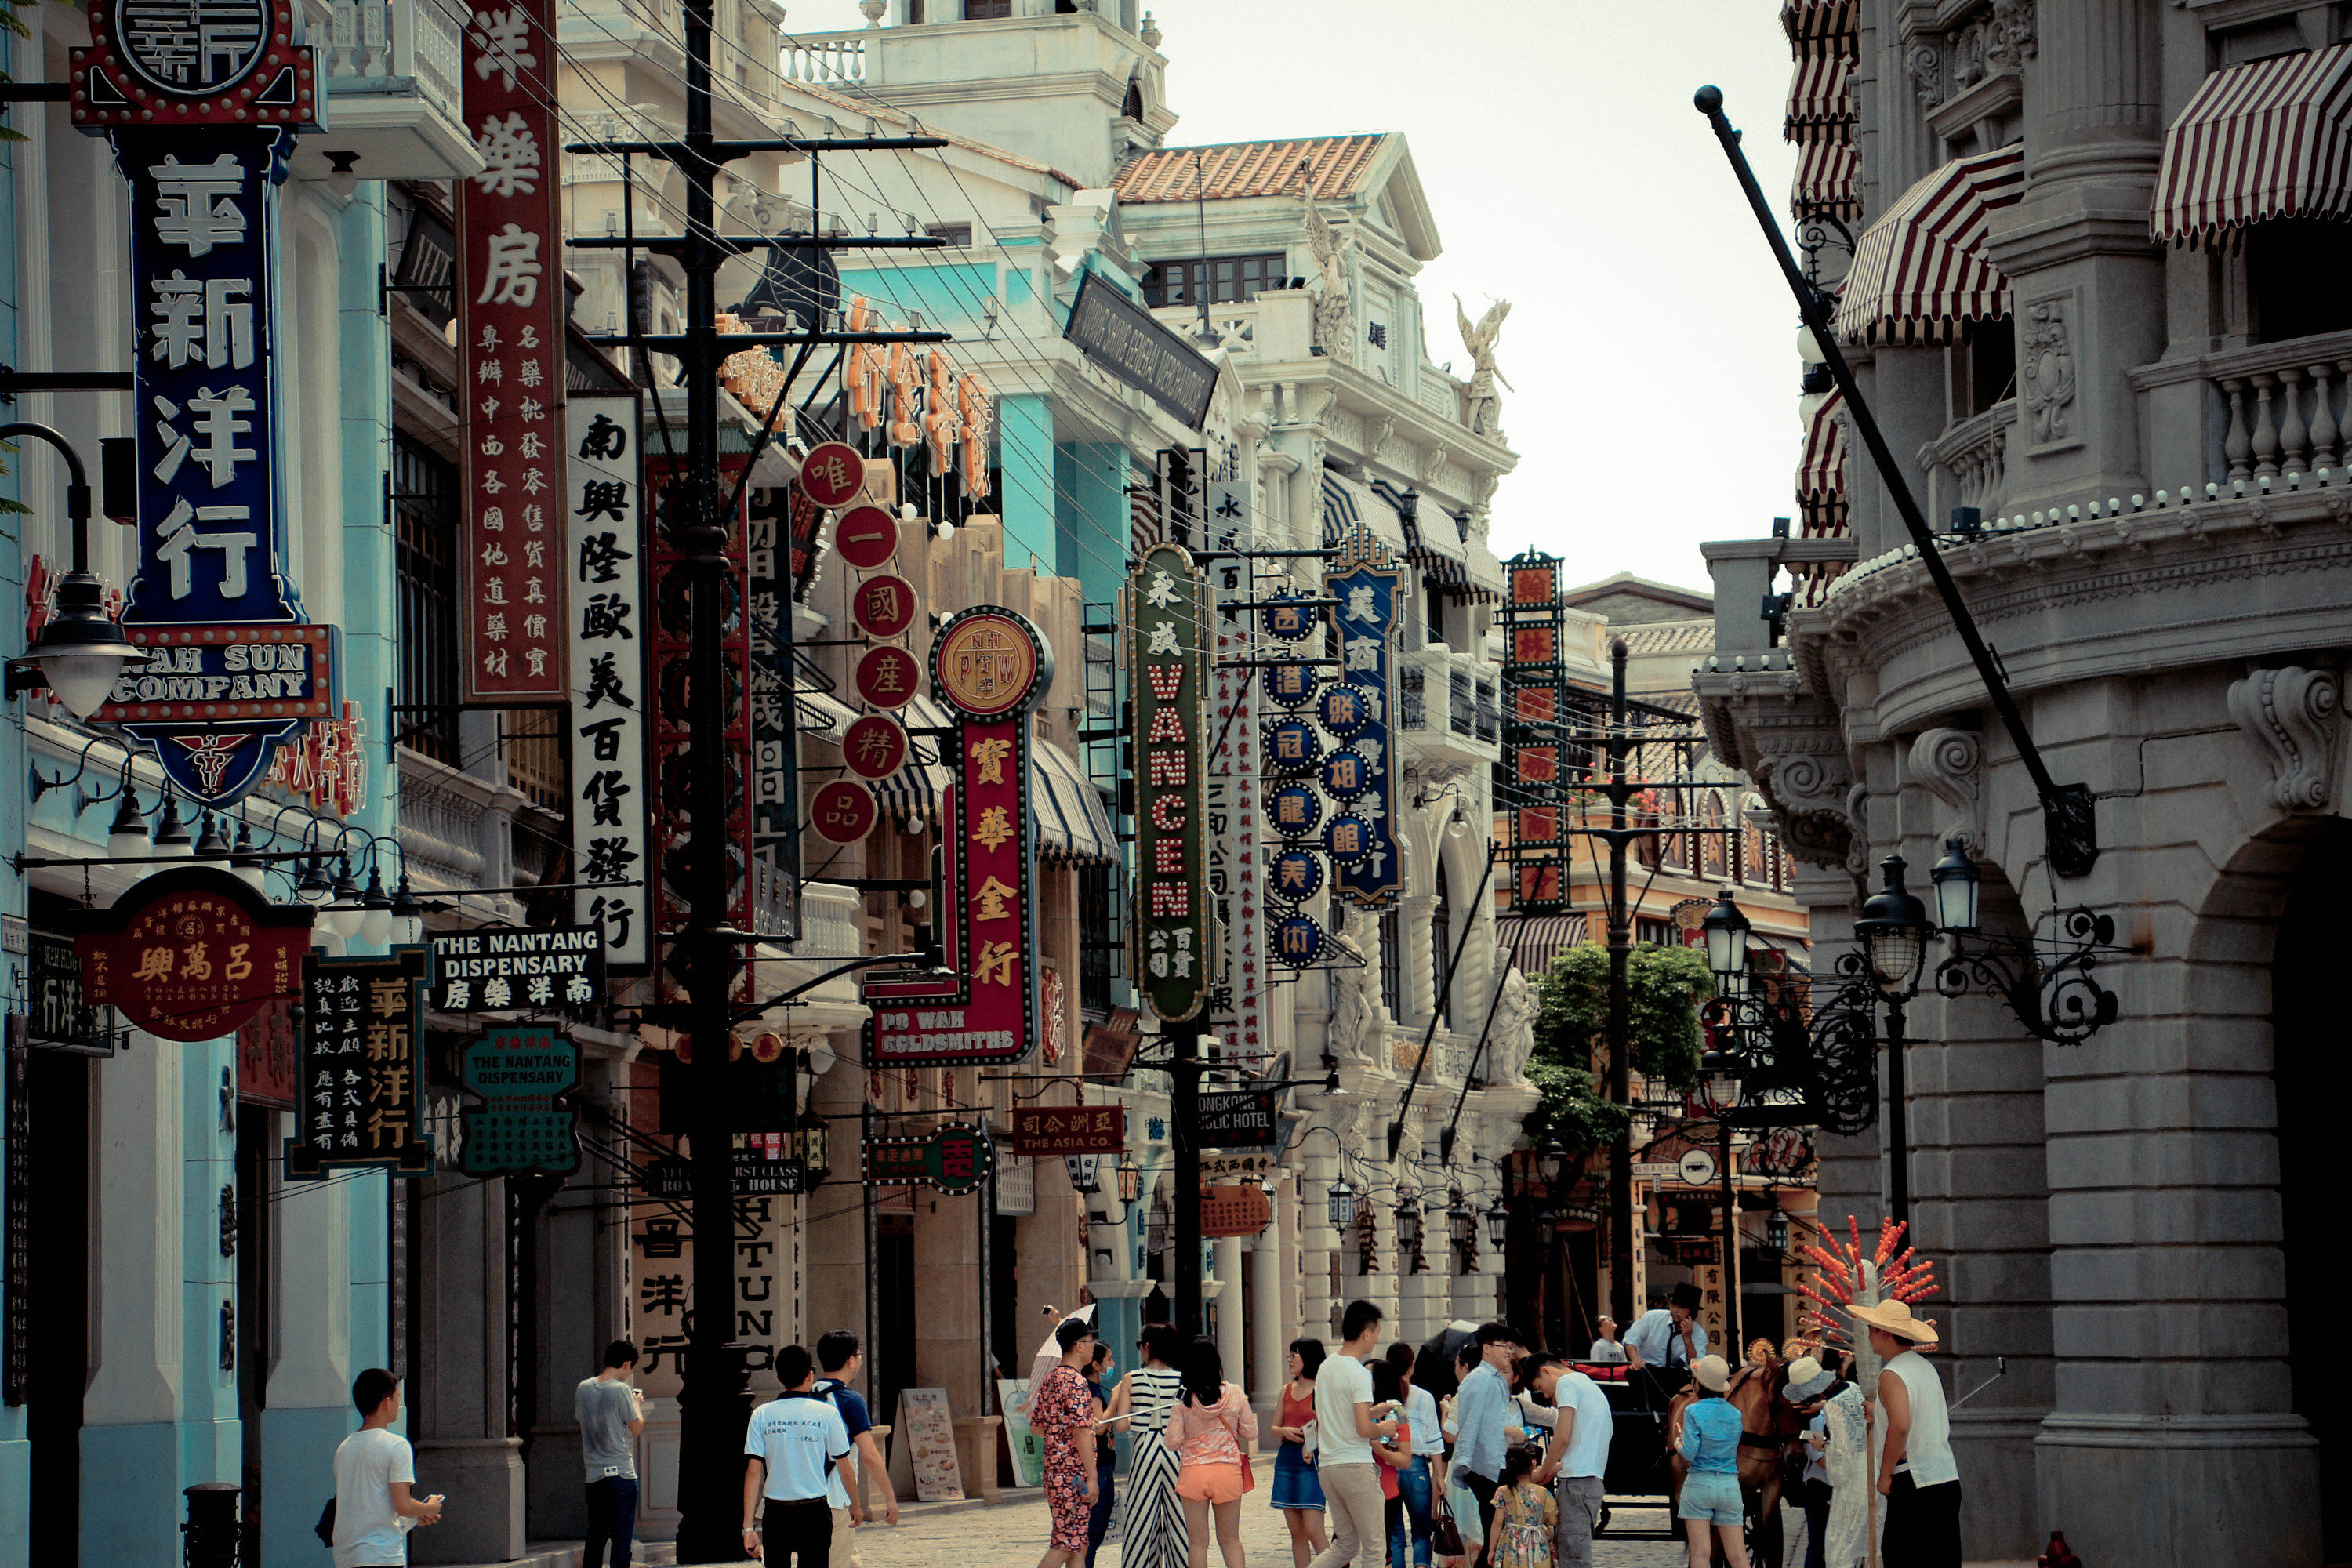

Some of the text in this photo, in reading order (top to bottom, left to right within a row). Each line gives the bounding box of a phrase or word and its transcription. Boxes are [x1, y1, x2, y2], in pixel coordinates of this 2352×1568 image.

[1124, 328, 1162, 385] GENERAL
[148, 154, 257, 600] 華新洋行
[224, 644, 306, 673] SUN
[111, 673, 307, 702] COMPANY
[574, 414, 639, 949] 南興隆歐美百貨發行
[969, 737, 1020, 988] 寶華金行
[434, 931, 598, 956] THE NANTANG
[1149, 928, 1169, 978] 公司
[445, 954, 588, 979] DISPENSARY
[312, 977, 335, 1056] 認真比較
[337, 975, 361, 1054] 歡迎主顧
[880, 1011, 965, 1032] PO WAH
[881, 1029, 1014, 1055] GOLDSMITHS
[366, 977, 411, 1149] 華新洋行
[472, 1055, 571, 1069] THE NANTANG
[478, 1071, 564, 1085] DISPENSARY
[1198, 1094, 1256, 1112] ONGKONG
[1233, 1112, 1271, 1129] HOTEL
[1023, 1136, 1112, 1149] THE ASIA CO.
[748, 1178, 799, 1192] HOUSE
[762, 1166, 799, 1177] CLASS
[1706, 1269, 1722, 1346] 有限公司
